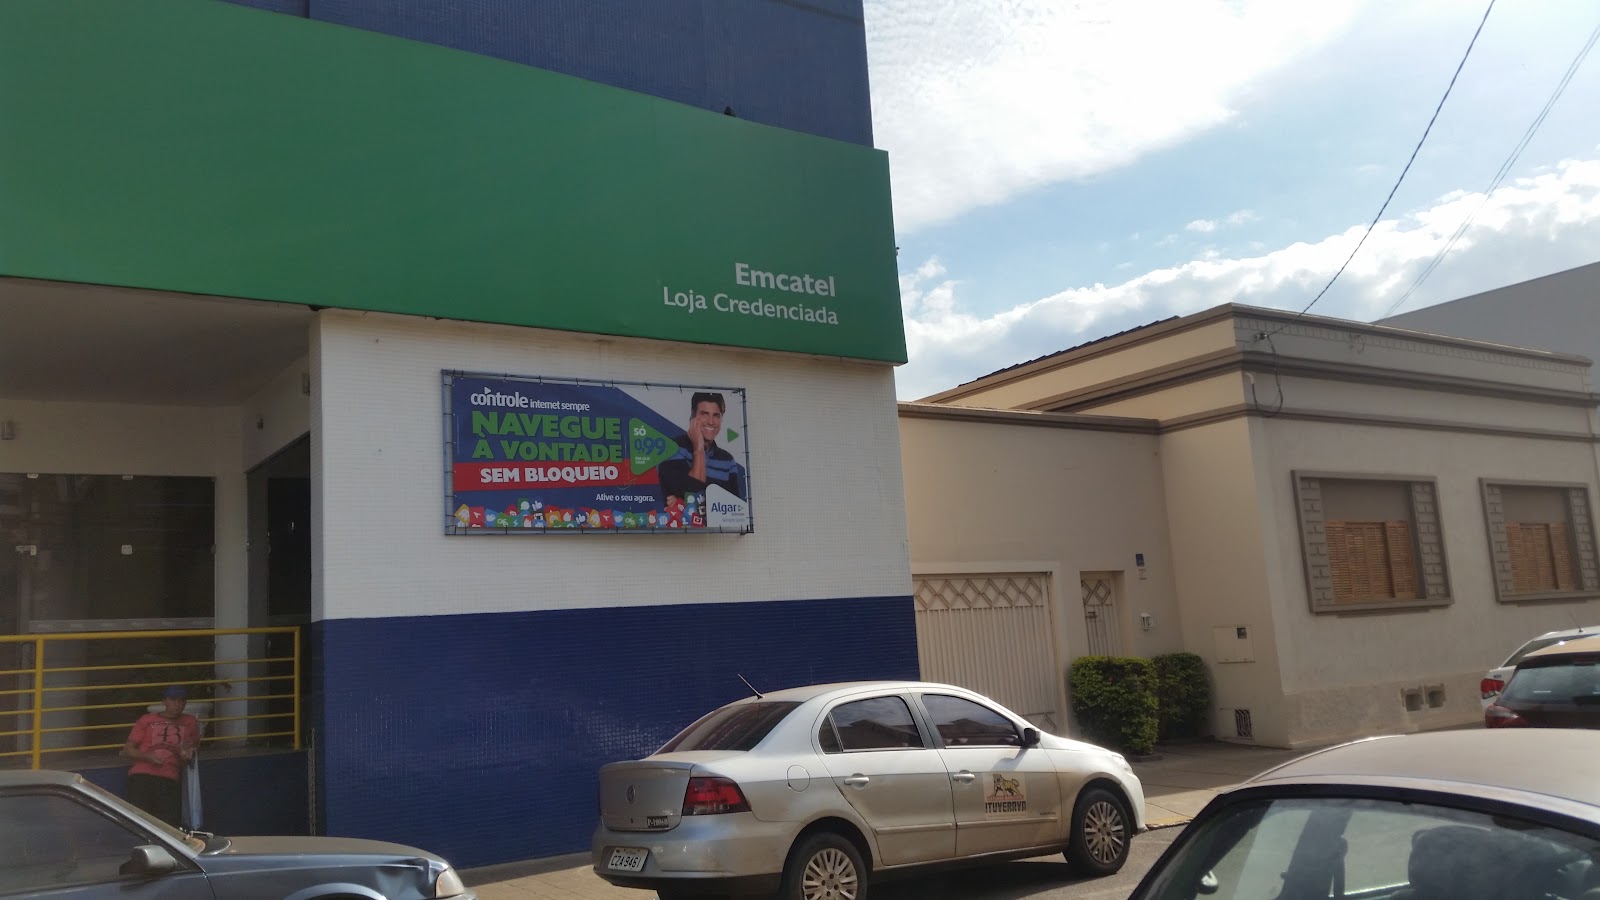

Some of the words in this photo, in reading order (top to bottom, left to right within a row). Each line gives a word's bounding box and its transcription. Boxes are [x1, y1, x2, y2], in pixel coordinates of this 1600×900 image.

[735, 262, 836, 297] Emcatel
[663, 286, 707, 314] Loja
[713, 293, 839, 325] Credenciada
[470, 391, 529, 408] controle
[530, 399, 561, 410] internet
[561, 402, 590, 412] sempre
[471, 410, 622, 440] NAVEGUE
[633, 425, 647, 436] SÓ
[471, 433, 495, 459] À
[500, 439, 623, 463] VONTADE
[480, 467, 520, 483] SEM
[524, 465, 619, 483] BLOQUEIO
[596, 493, 614, 502] Ative
[633, 495, 655, 504] agora.
[711, 502, 737, 515] Algar
